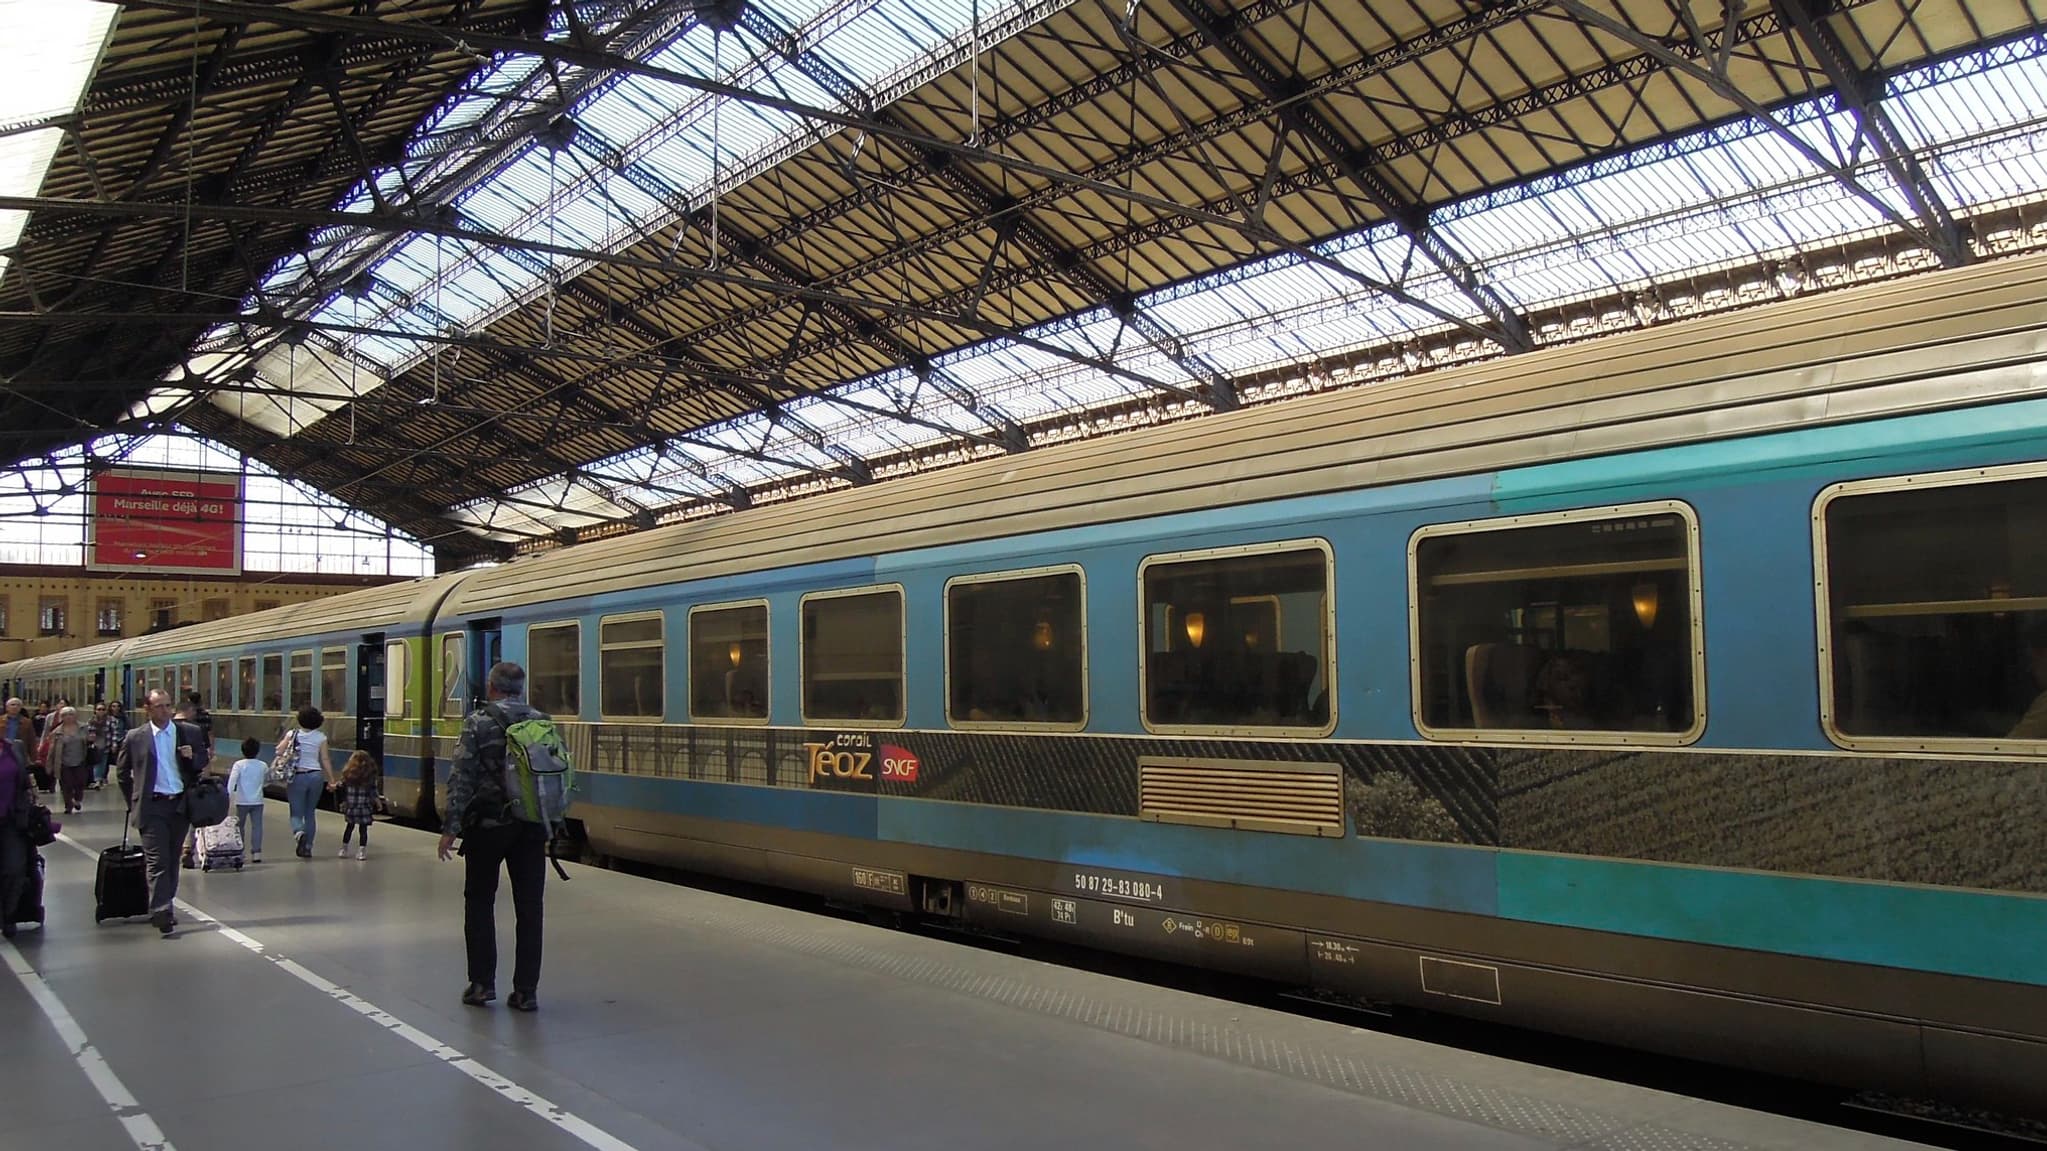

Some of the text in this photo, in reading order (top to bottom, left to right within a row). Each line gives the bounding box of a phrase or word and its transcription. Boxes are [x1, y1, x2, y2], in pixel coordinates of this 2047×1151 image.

[113, 498, 169, 511] Marseille
[172, 499, 197, 515] déjà
[836, 732, 872, 748] corail
[803, 740, 873, 784] Téoz
[882, 758, 917, 776] SNCF
[1075, 874, 1163, 900] 50 87 29-83 080-4
